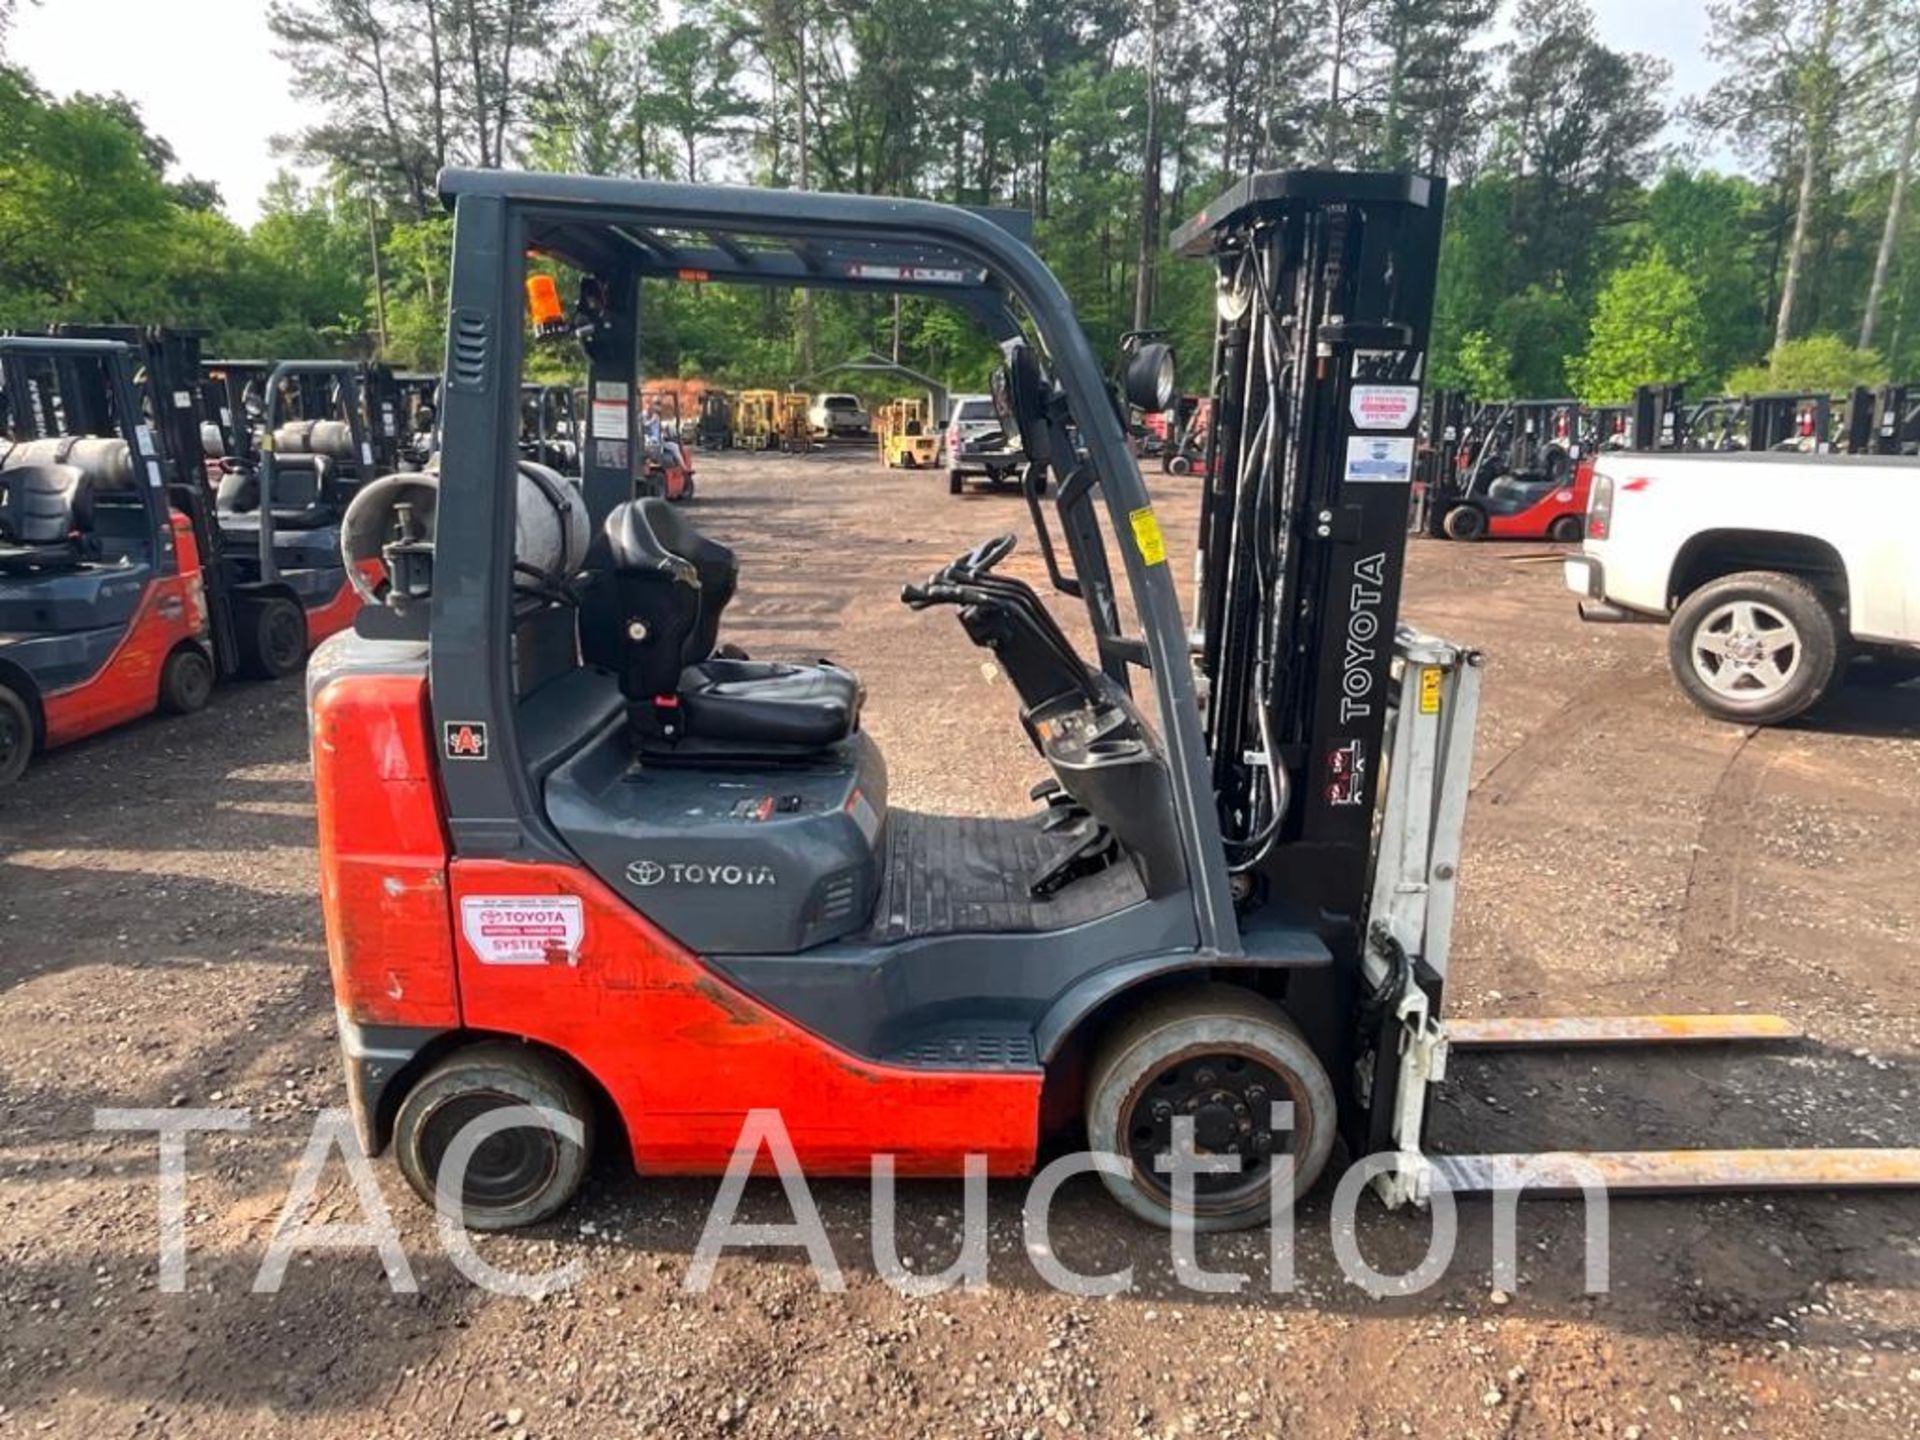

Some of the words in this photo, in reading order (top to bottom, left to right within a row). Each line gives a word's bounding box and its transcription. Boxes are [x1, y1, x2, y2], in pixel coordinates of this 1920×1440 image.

[28, 378, 47, 439] NISSAN
[1340, 551, 1386, 725] TOYOTA
[667, 863, 776, 885] TOYOTA
[505, 911, 565, 923] TOYOTA
